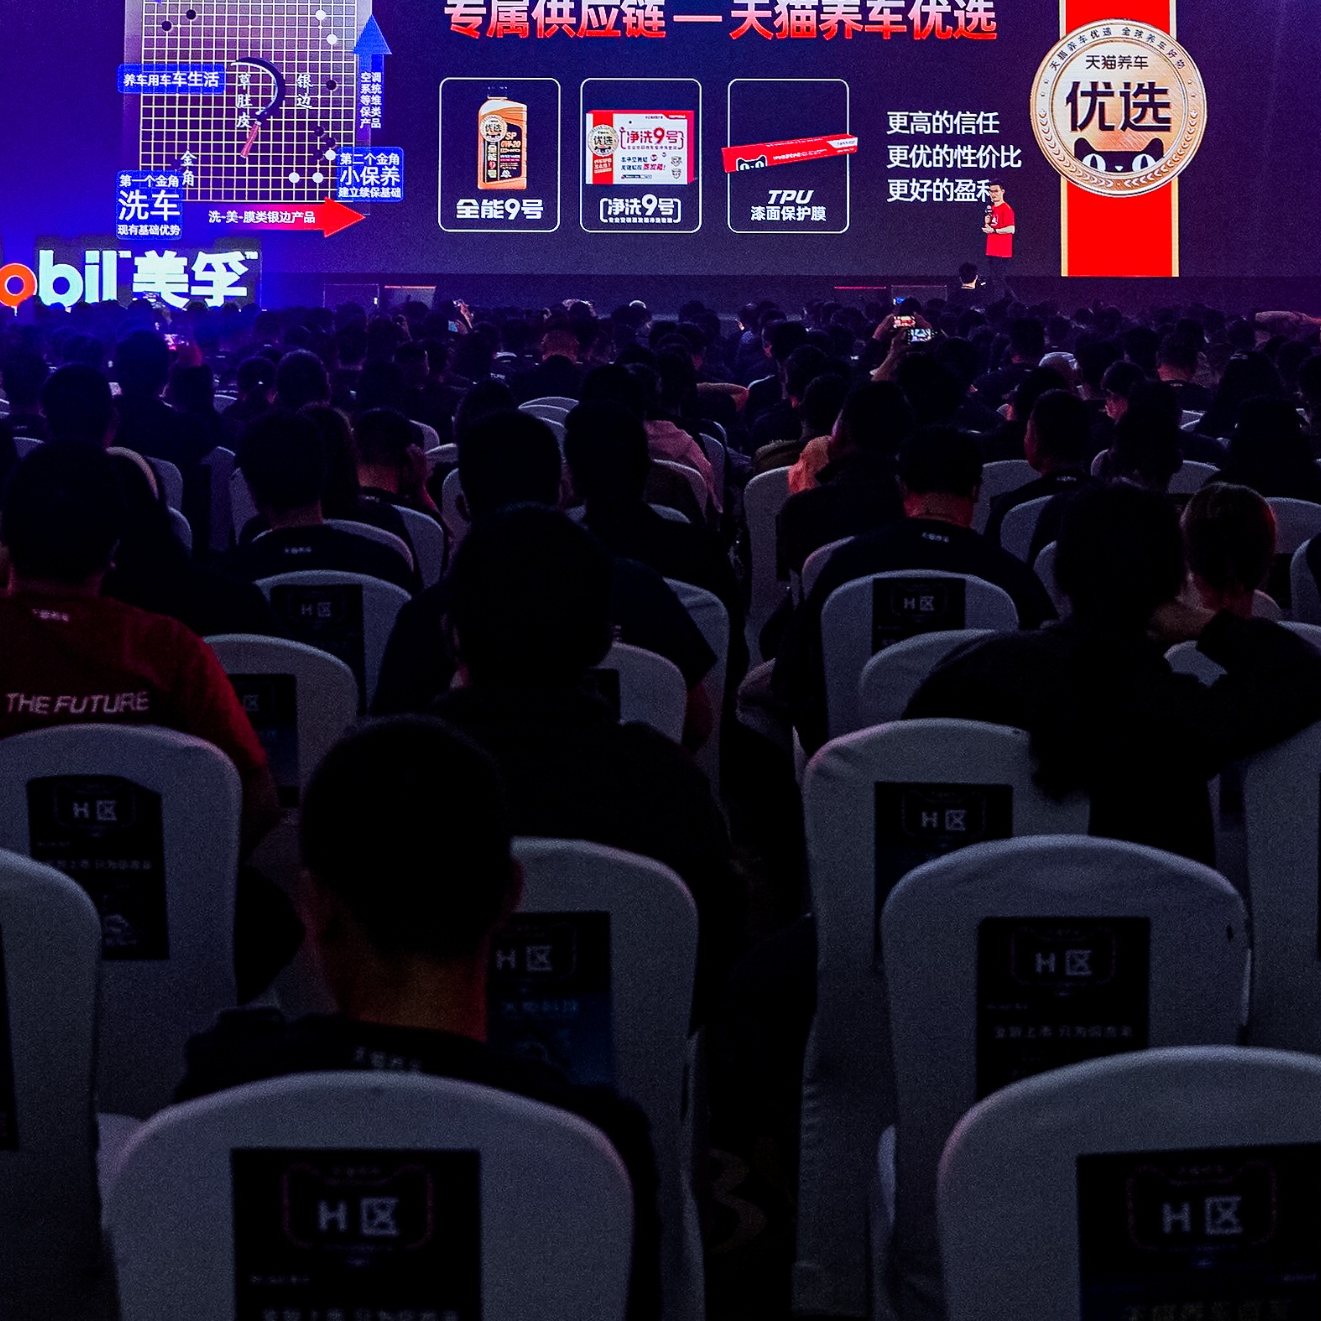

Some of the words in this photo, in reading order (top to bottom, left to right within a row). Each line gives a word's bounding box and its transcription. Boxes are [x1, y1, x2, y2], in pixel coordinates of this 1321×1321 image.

[1085, 54, 1149, 70] 天猫养车
[296, 74, 314, 108] 银边
[1065, 81, 1172, 133] 优选
[886, 110, 1000, 135] 更高的信任
[626, 127, 678, 144] 净洗9号
[181, 150, 197, 187] 金角
[340, 153, 400, 165] 第二个金角
[886, 144, 1023, 169] 更优的性价比
[119, 174, 179, 187] 第一个金角
[340, 166, 400, 186] 小保养
[118, 189, 180, 221] 洗车
[456, 198, 544, 220] 全能9号
[607, 194, 675, 216] 净洗9号
[768, 190, 814, 205] TPU
[751, 206, 827, 222] 漆面保护膜
[117, 224, 181, 237] 现有基础优势
[4, 692, 52, 715] THE
[51, 691, 151, 714] FUTURE
[72, 799, 118, 822] H区
[920, 808, 967, 832] H区
[495, 944, 555, 973] H区
[1034, 948, 1094, 976] H区
[316, 1195, 402, 1237] H区
[1161, 1194, 1244, 1235] H区
